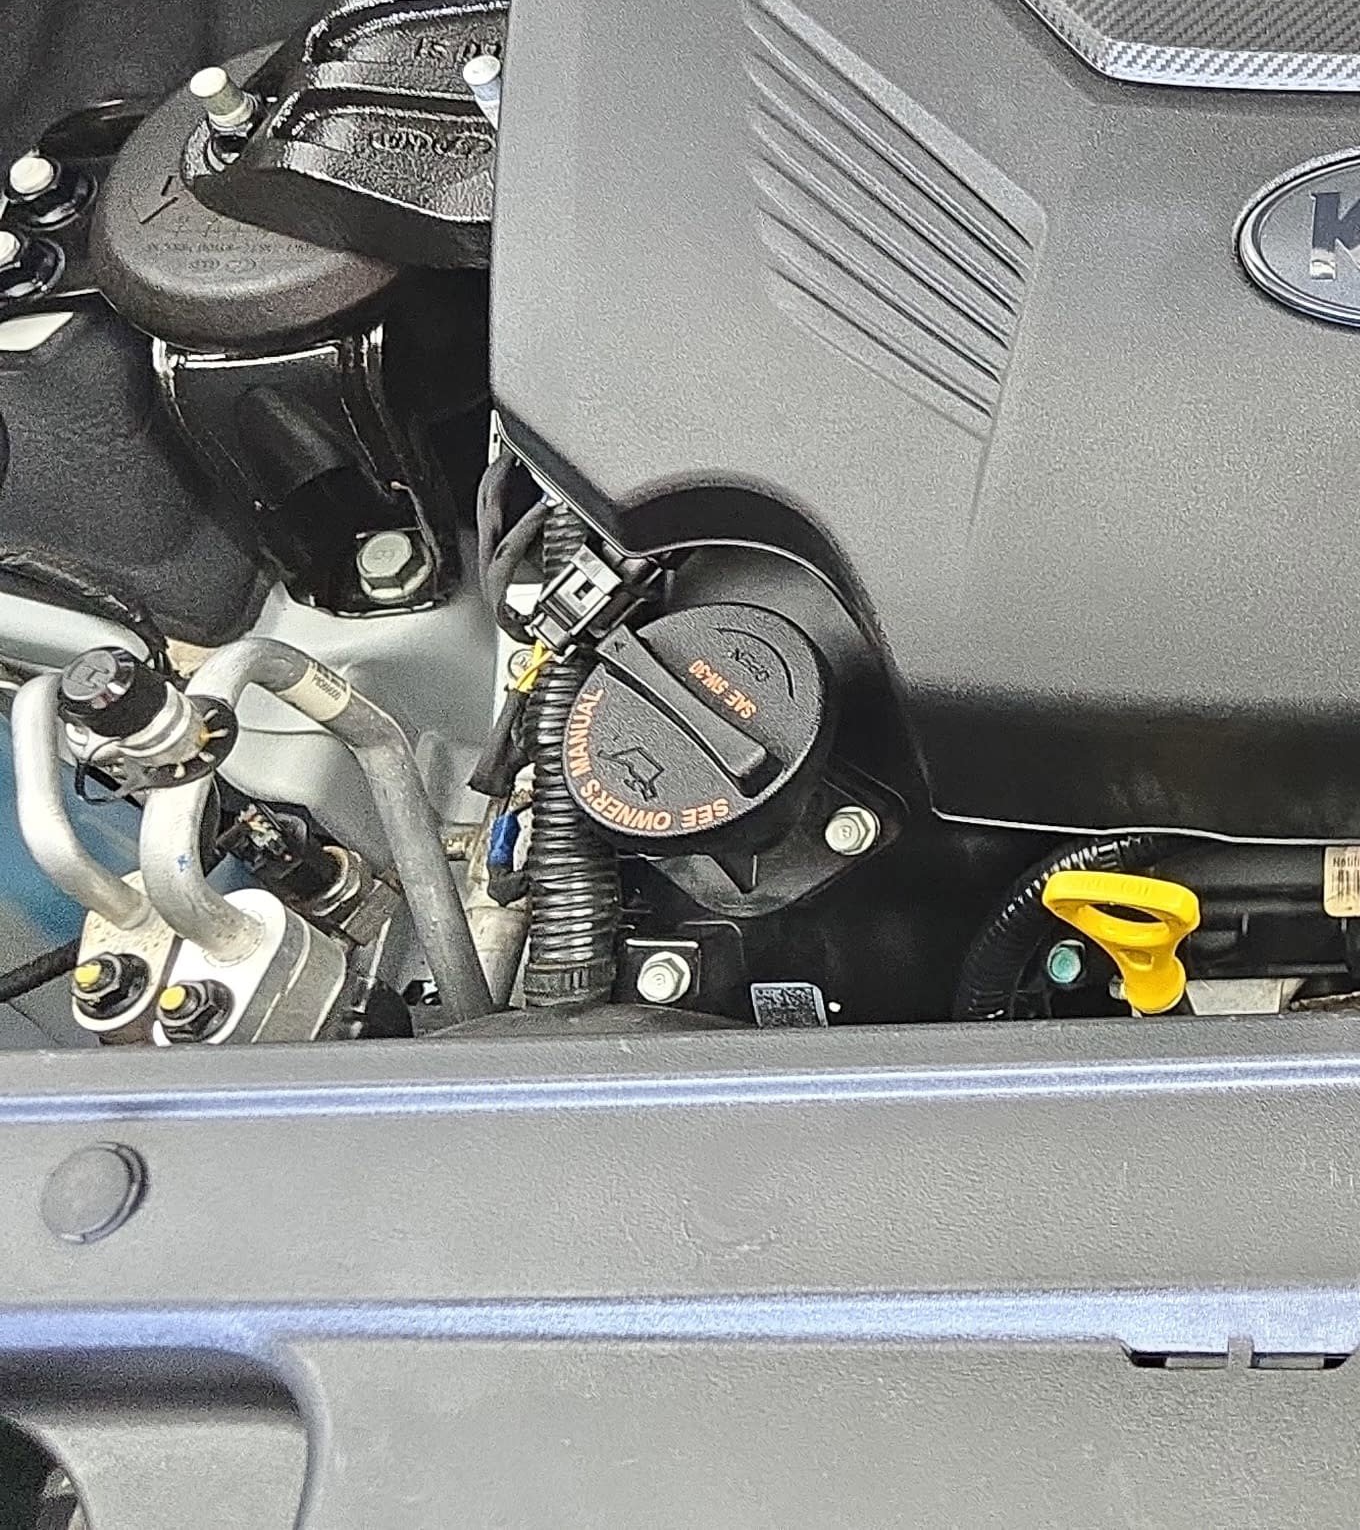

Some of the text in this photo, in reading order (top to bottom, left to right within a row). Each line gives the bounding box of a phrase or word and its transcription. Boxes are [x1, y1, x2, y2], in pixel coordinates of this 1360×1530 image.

[689, 659, 757, 719] SAE 5W-30
[567, 687, 605, 779] MANUAL
[579, 778, 674, 832] OWNER'S
[680, 797, 731, 829] SEE
